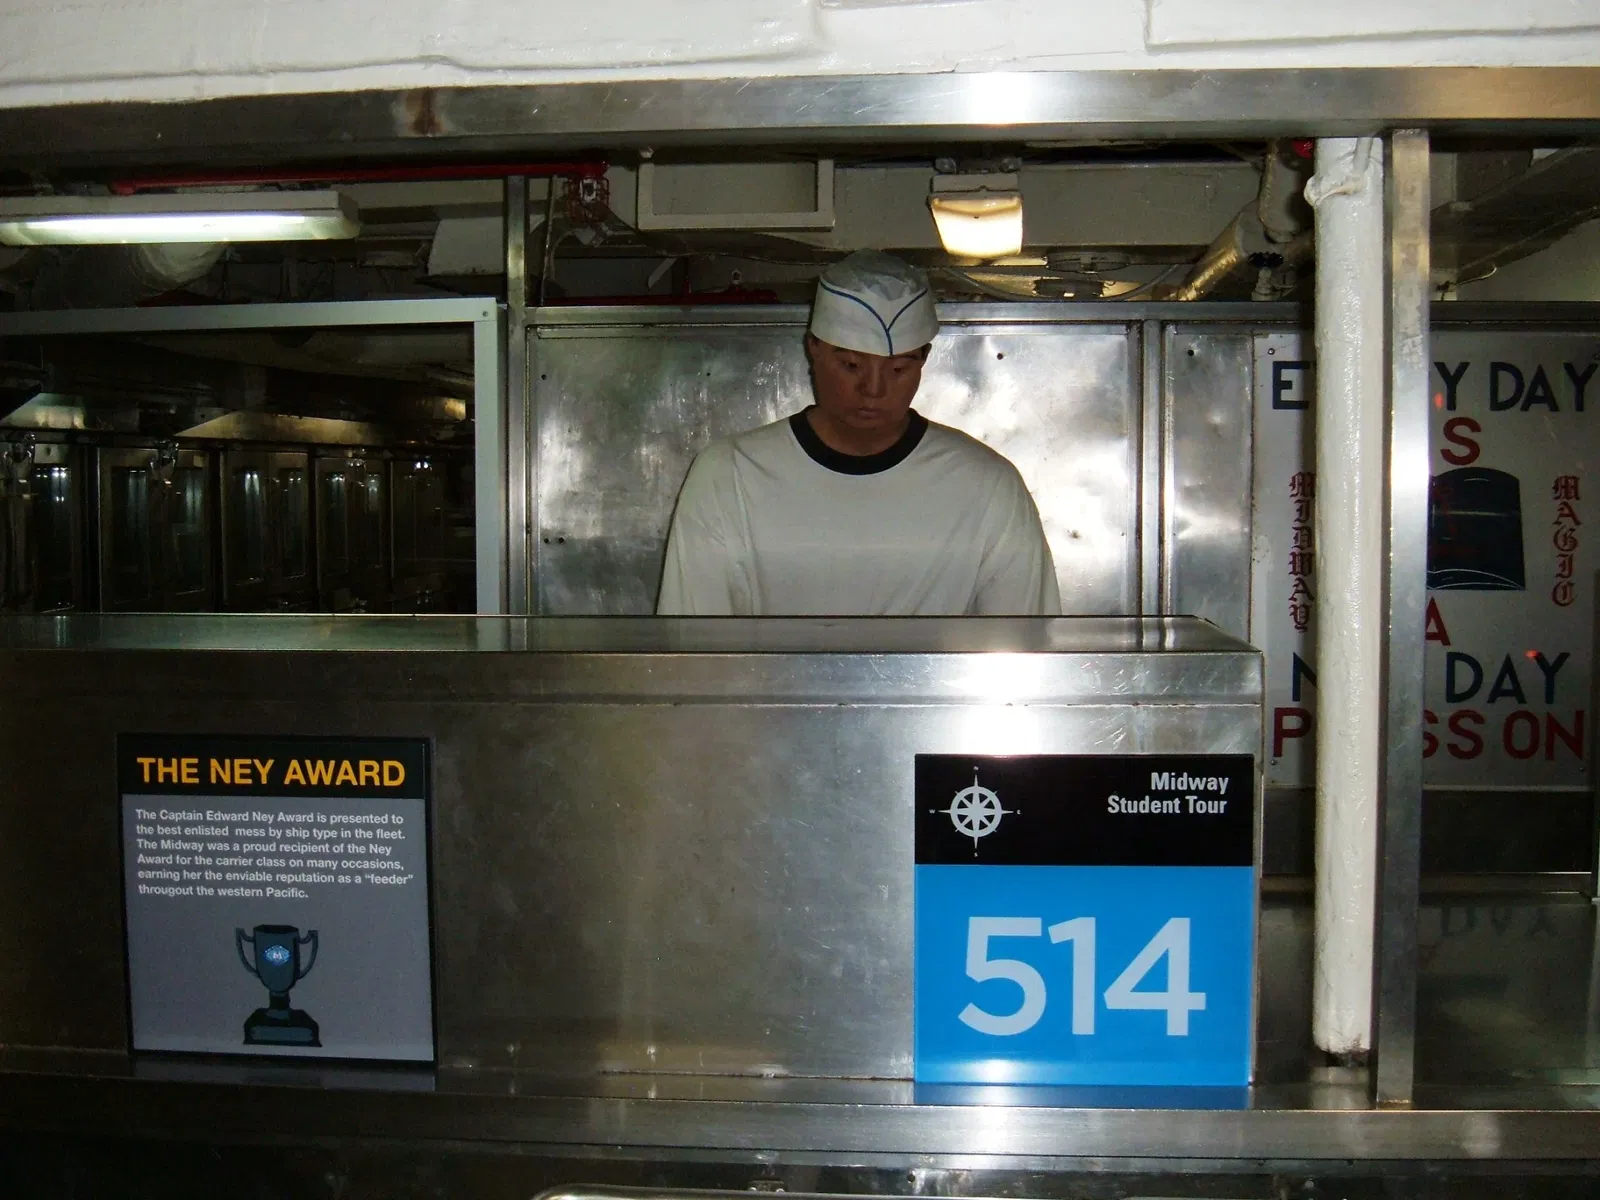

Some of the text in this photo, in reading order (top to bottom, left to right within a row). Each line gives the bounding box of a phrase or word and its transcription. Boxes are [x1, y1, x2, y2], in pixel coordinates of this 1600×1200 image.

[1490, 361, 1600, 412] DAY
[1552, 475, 1582, 607] MAGIC
[1446, 651, 1570, 704] DAY
[137, 757, 406, 787] THE NEY AWARD
[1151, 772, 1229, 794] Midway
[1107, 795, 1227, 815] Student Tour
[136, 809, 403, 825] The Captain Edward Ney Award is presented to
[136, 824, 405, 840] the best enlisted mess by ship type in the fleet.
[136, 838, 392, 856] The Midway was a proud recipient of the Ney
[137, 853, 404, 871] Award for the carrier class on many occasions,
[138, 869, 180, 881] earning
[183, 869, 202, 880] her
[204, 870, 223, 880] the
[225, 871, 273, 882] enviable
[276, 872, 334, 884] reputation
[337, 875, 351, 883] as
[365, 874, 413, 884] “feeder”
[138, 884, 308, 898] througout the western Pacific.
[957, 916, 1206, 1036] 514
